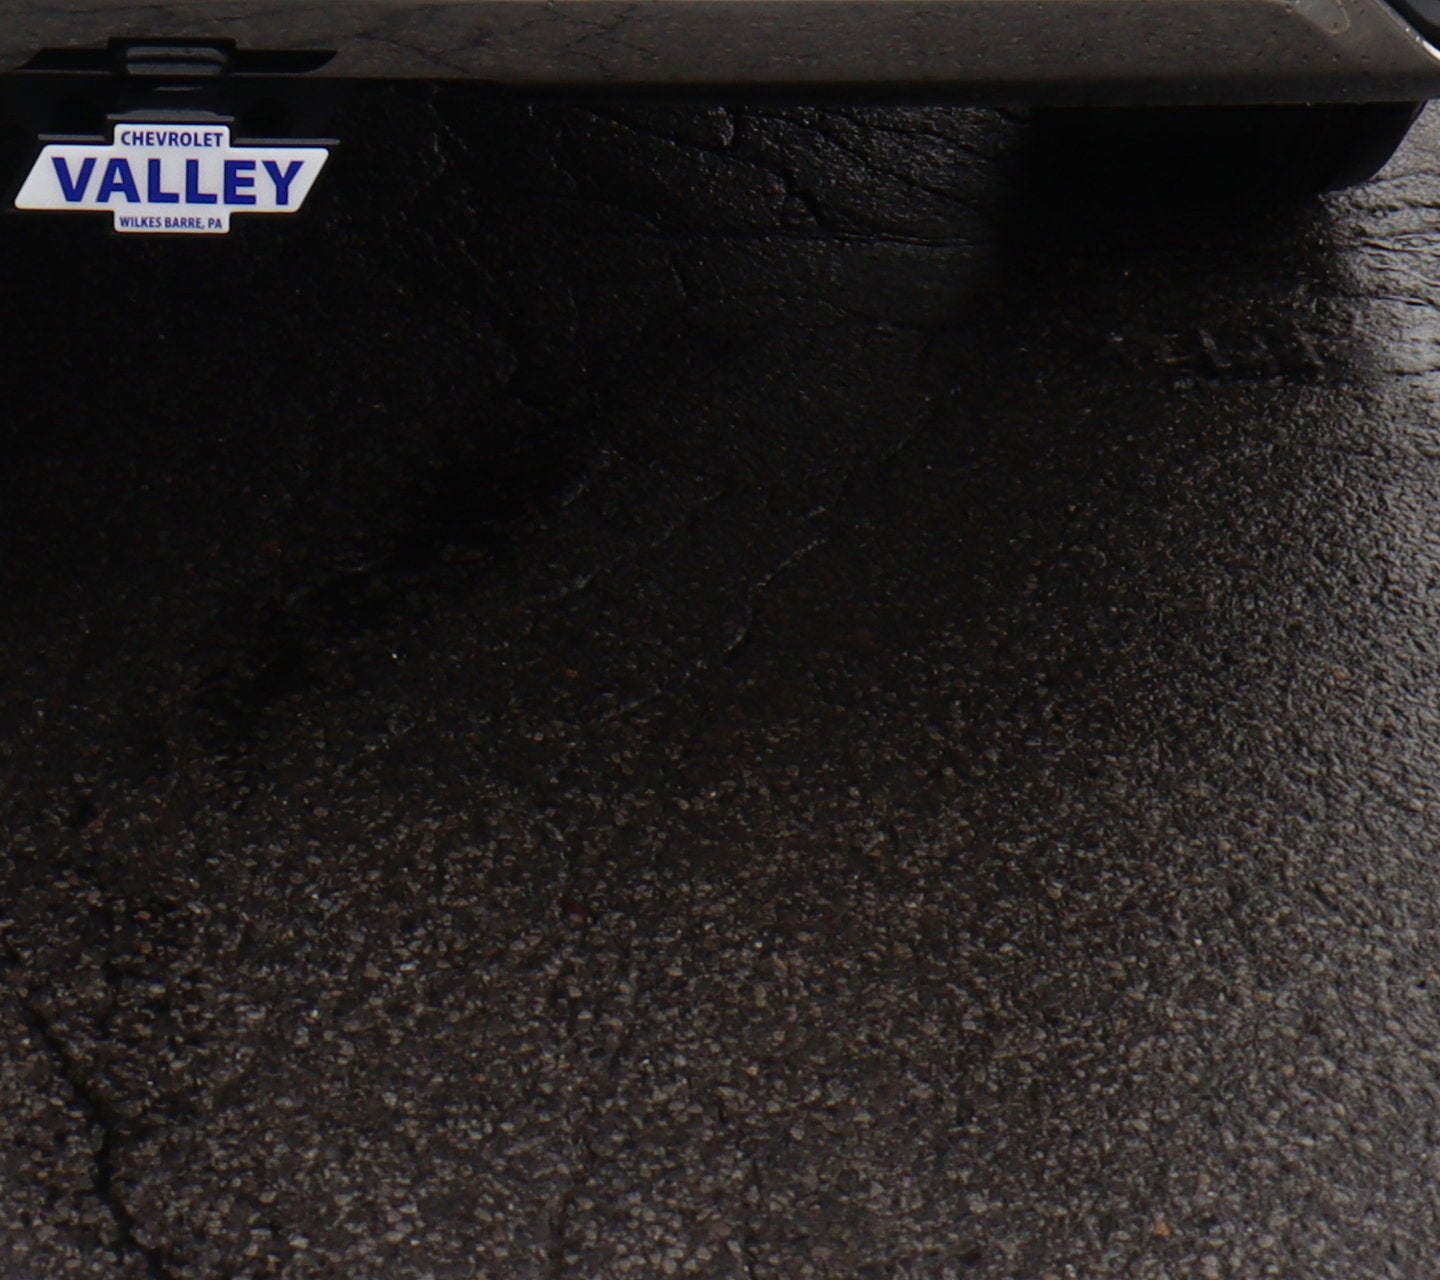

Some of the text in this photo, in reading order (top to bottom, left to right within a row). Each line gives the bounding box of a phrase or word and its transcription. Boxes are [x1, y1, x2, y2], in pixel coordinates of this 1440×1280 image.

[120, 131, 224, 148] CHEVROLET
[51, 156, 305, 206] VALLEY
[119, 216, 223, 230] WILKES BARRE, PA
